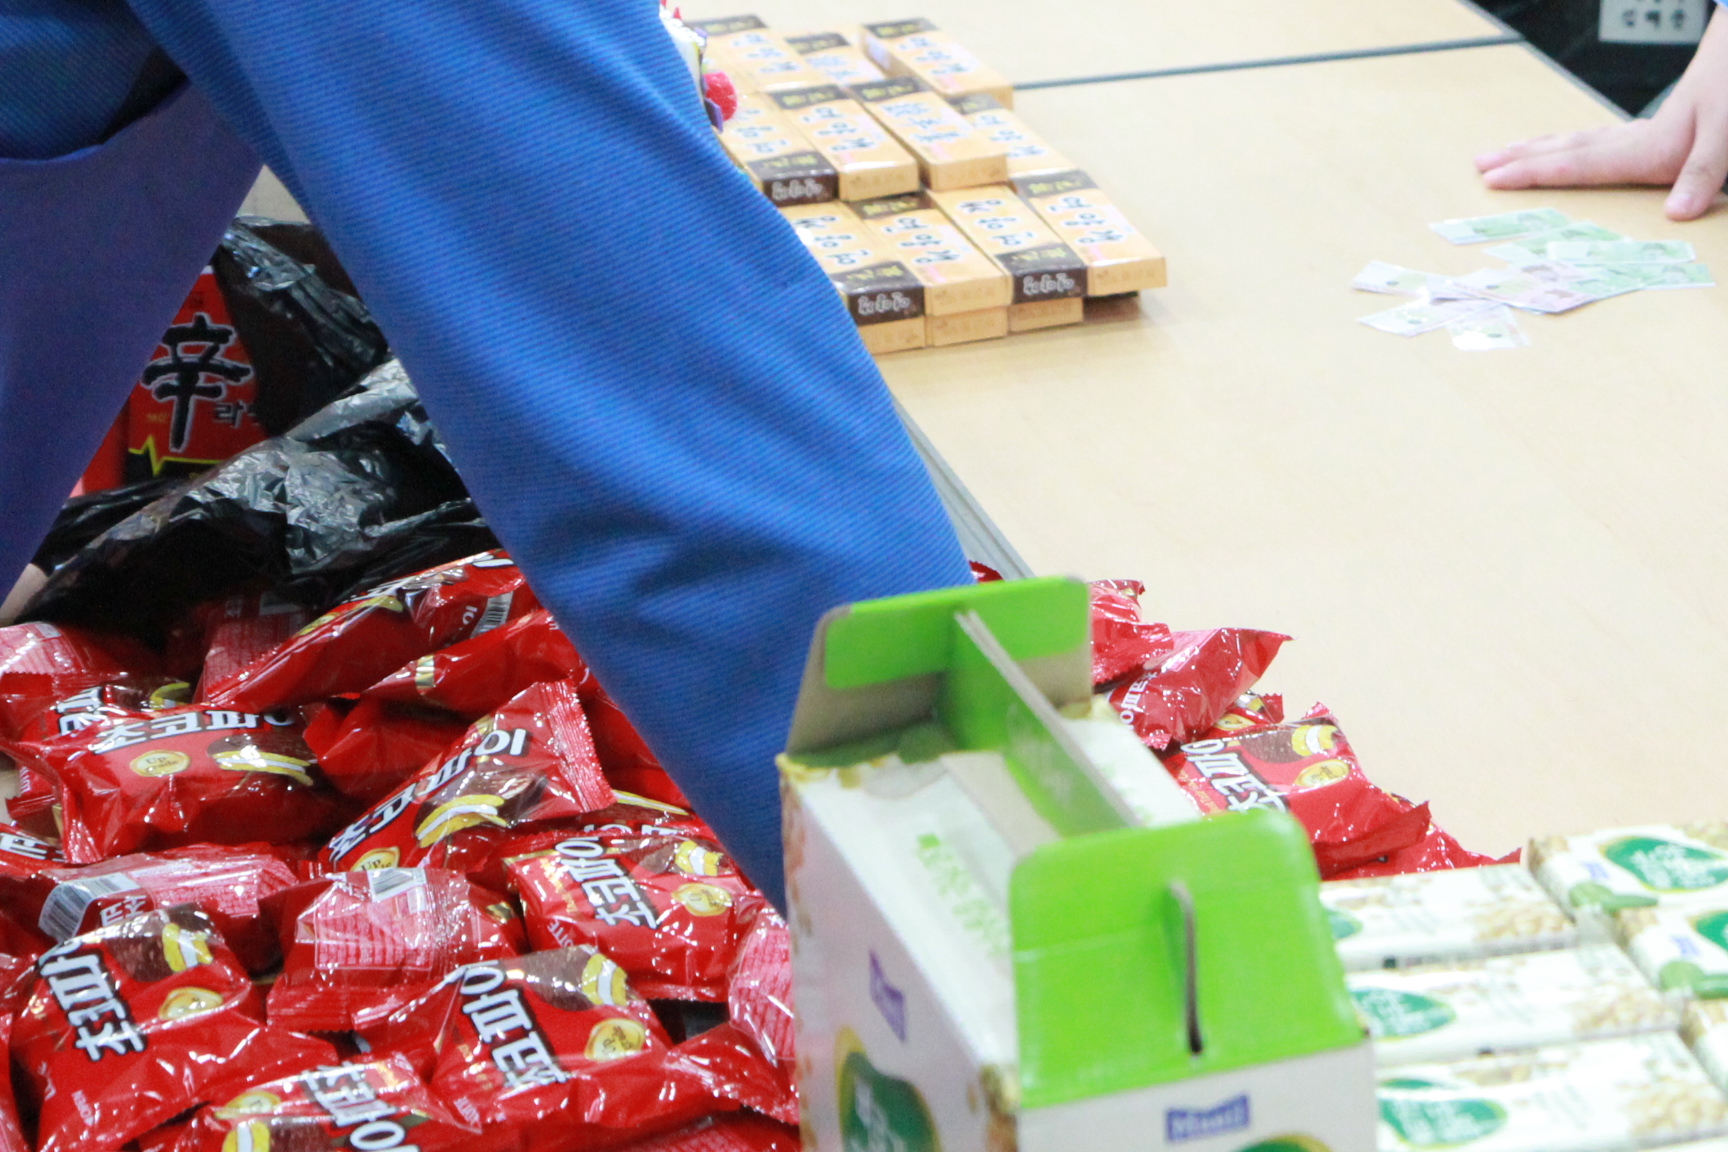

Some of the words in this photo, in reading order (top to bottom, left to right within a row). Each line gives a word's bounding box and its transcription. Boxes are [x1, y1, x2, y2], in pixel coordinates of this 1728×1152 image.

[140, 312, 255, 453] 辛
[327, 727, 529, 864] 초코파이
[101, 894, 147, 927] 초코
[547, 919, 574, 948] OTTE
[554, 836, 658, 931] 초코파이
[38, 939, 146, 1061] 초코파이
[450, 959, 570, 1090] 초코파이
